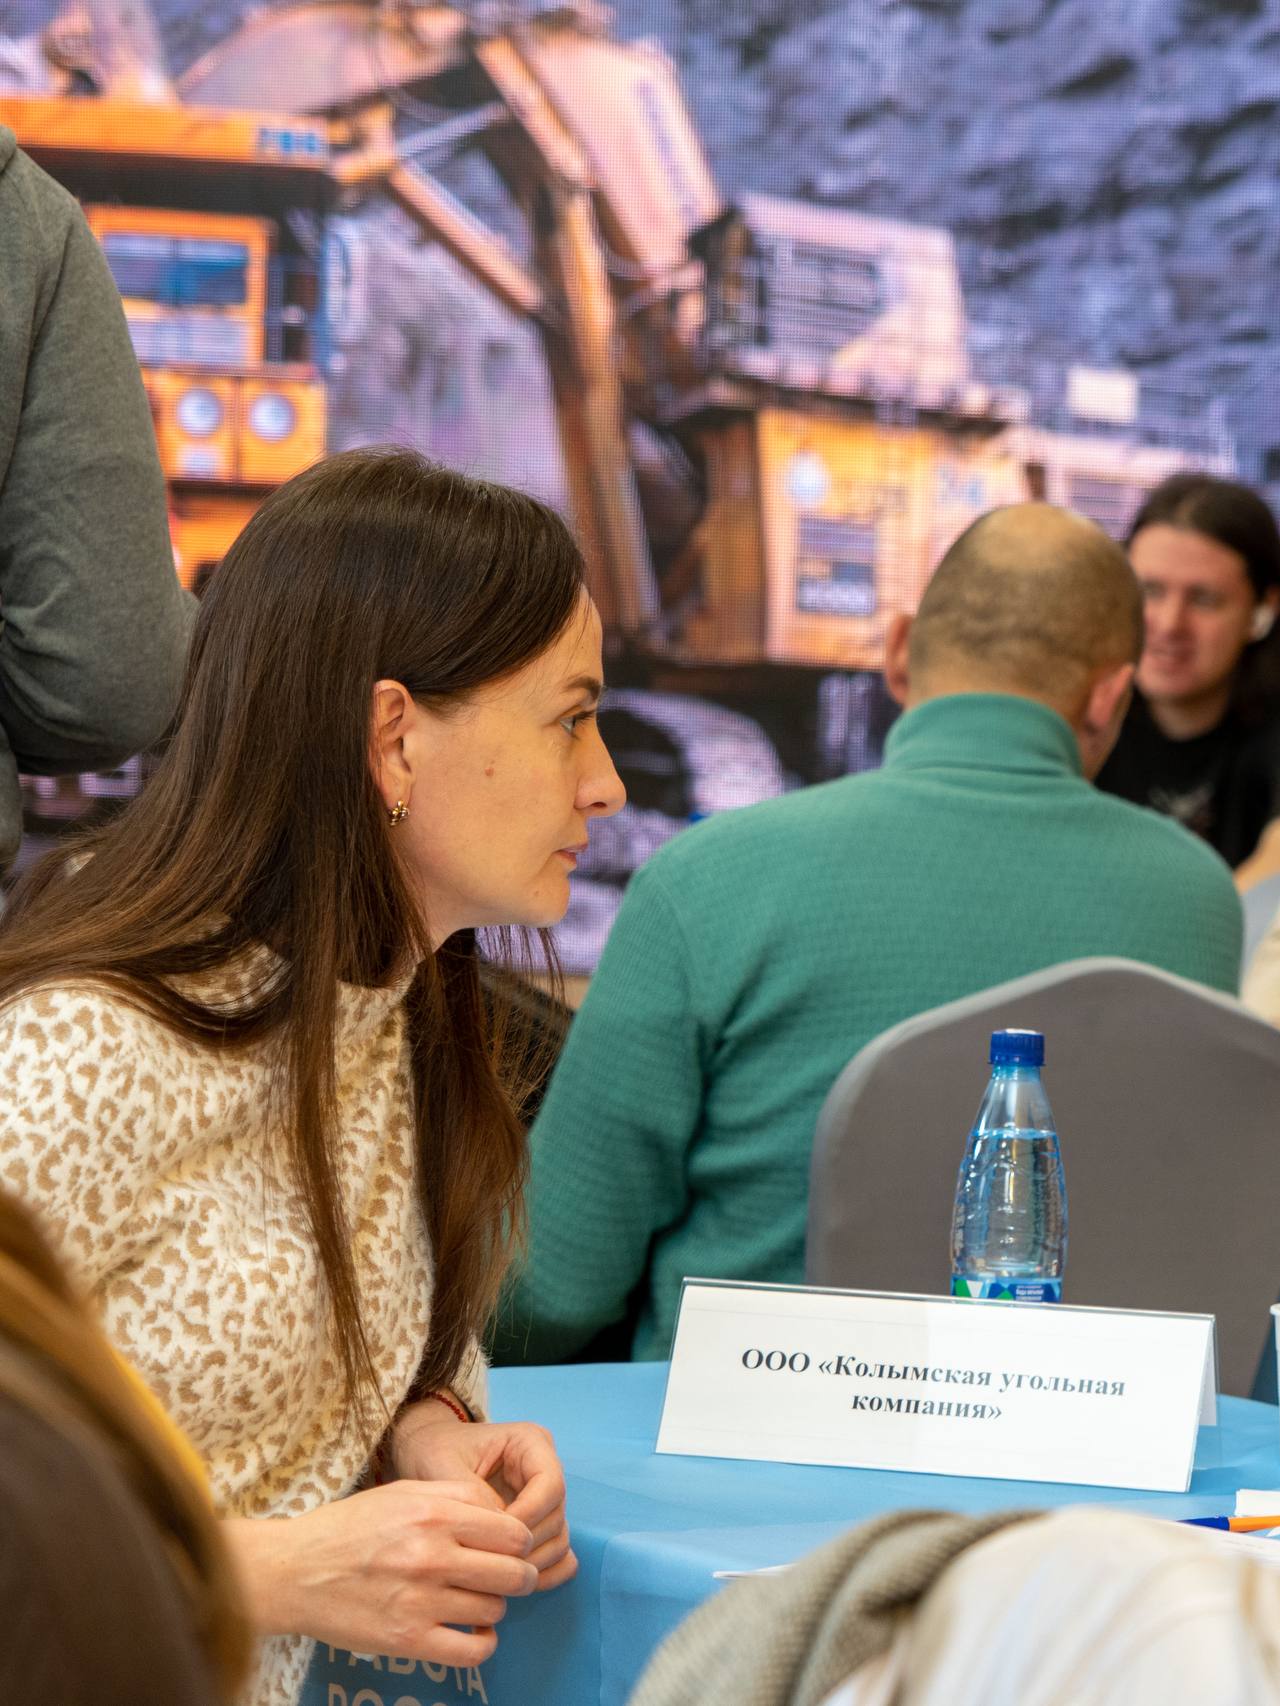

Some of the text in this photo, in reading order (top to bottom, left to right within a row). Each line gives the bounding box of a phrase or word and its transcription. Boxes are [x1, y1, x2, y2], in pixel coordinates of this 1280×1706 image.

[742, 1348, 1126, 1396] ООО «Колымская угольная
[852, 1395, 1003, 1420] компания»
